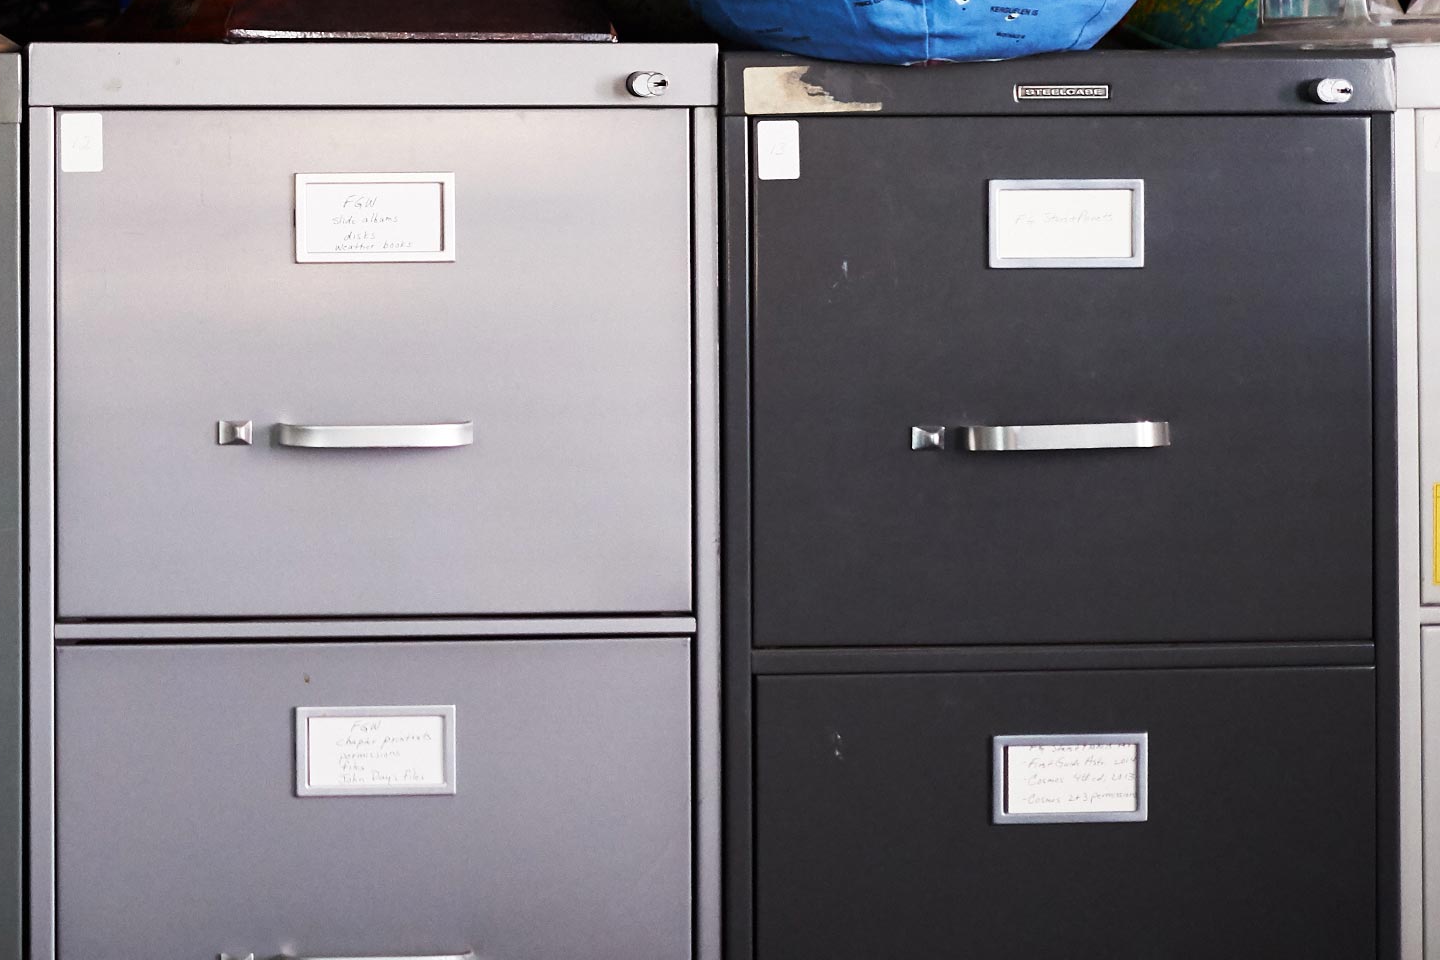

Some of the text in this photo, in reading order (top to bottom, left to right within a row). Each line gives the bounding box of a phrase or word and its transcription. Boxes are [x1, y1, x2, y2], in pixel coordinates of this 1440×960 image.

[990, 6, 1031, 16] KERGUELEN
[1025, 88, 1105, 96] STEELCASE
[343, 195, 377, 209] FGW
[362, 213, 398, 224] albums
[343, 231, 375, 241] disks
[383, 240, 411, 249] books
[351, 720, 382, 732] FGW
